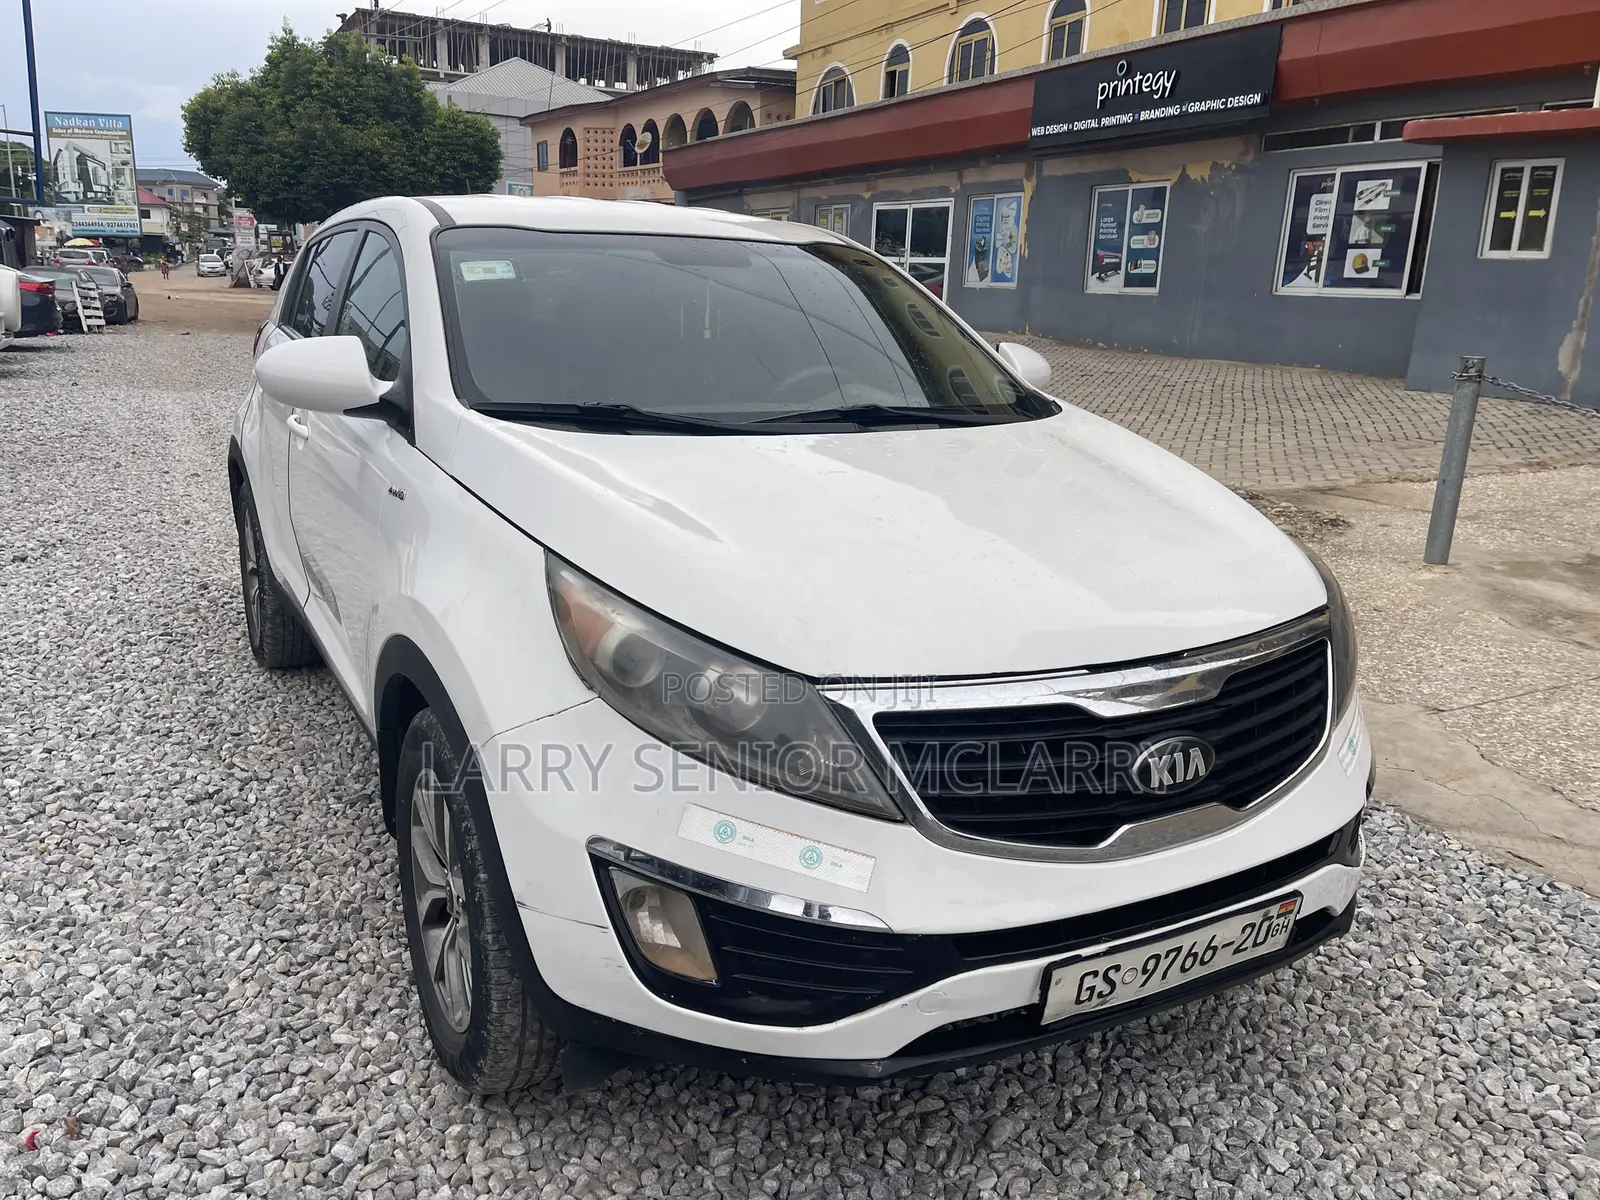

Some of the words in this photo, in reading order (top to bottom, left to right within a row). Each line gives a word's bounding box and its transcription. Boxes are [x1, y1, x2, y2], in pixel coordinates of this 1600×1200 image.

[1096, 59, 1176, 109] printegy
[54, 116, 96, 127] Nadkan
[98, 118, 123, 128] Villa
[1031, 124, 1045, 137] WEB
[1045, 122, 1069, 135] DESIGN
[1073, 117, 1099, 131] DIGITAL
[1100, 112, 1133, 128] PRINTING
[1140, 104, 1181, 121] BRANDING
[1187, 97, 1226, 113] GRAPHIC
[1227, 92, 1261, 109] DESIGN
[1148, 747, 1206, 788] KIA
[1270, 918, 1291, 938] GH
[1074, 963, 1122, 1005] GS
[1139, 915, 1274, 988] 9766-20
